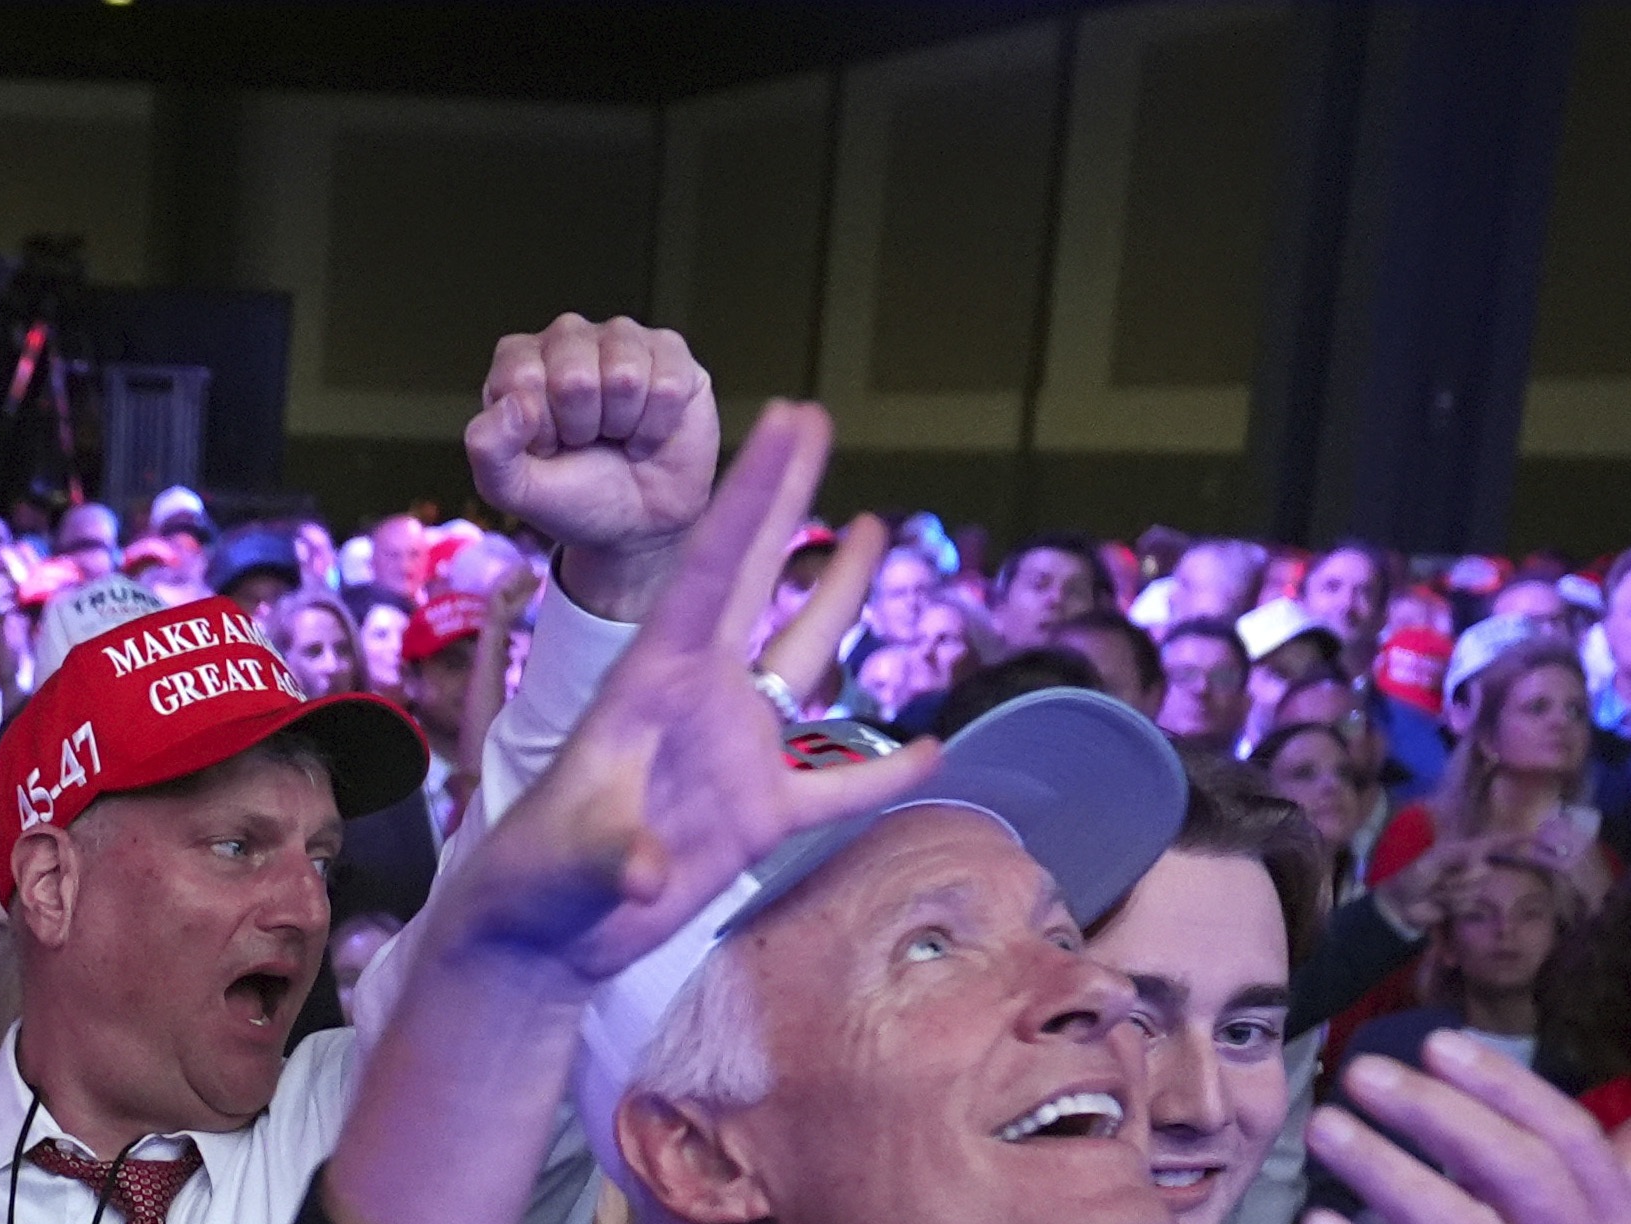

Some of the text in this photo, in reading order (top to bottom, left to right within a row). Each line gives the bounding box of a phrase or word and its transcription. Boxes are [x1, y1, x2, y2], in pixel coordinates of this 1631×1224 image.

[101, 617, 220, 678] MAKE
[148, 658, 269, 716] GREAT
[17, 720, 101, 832] 45-47
